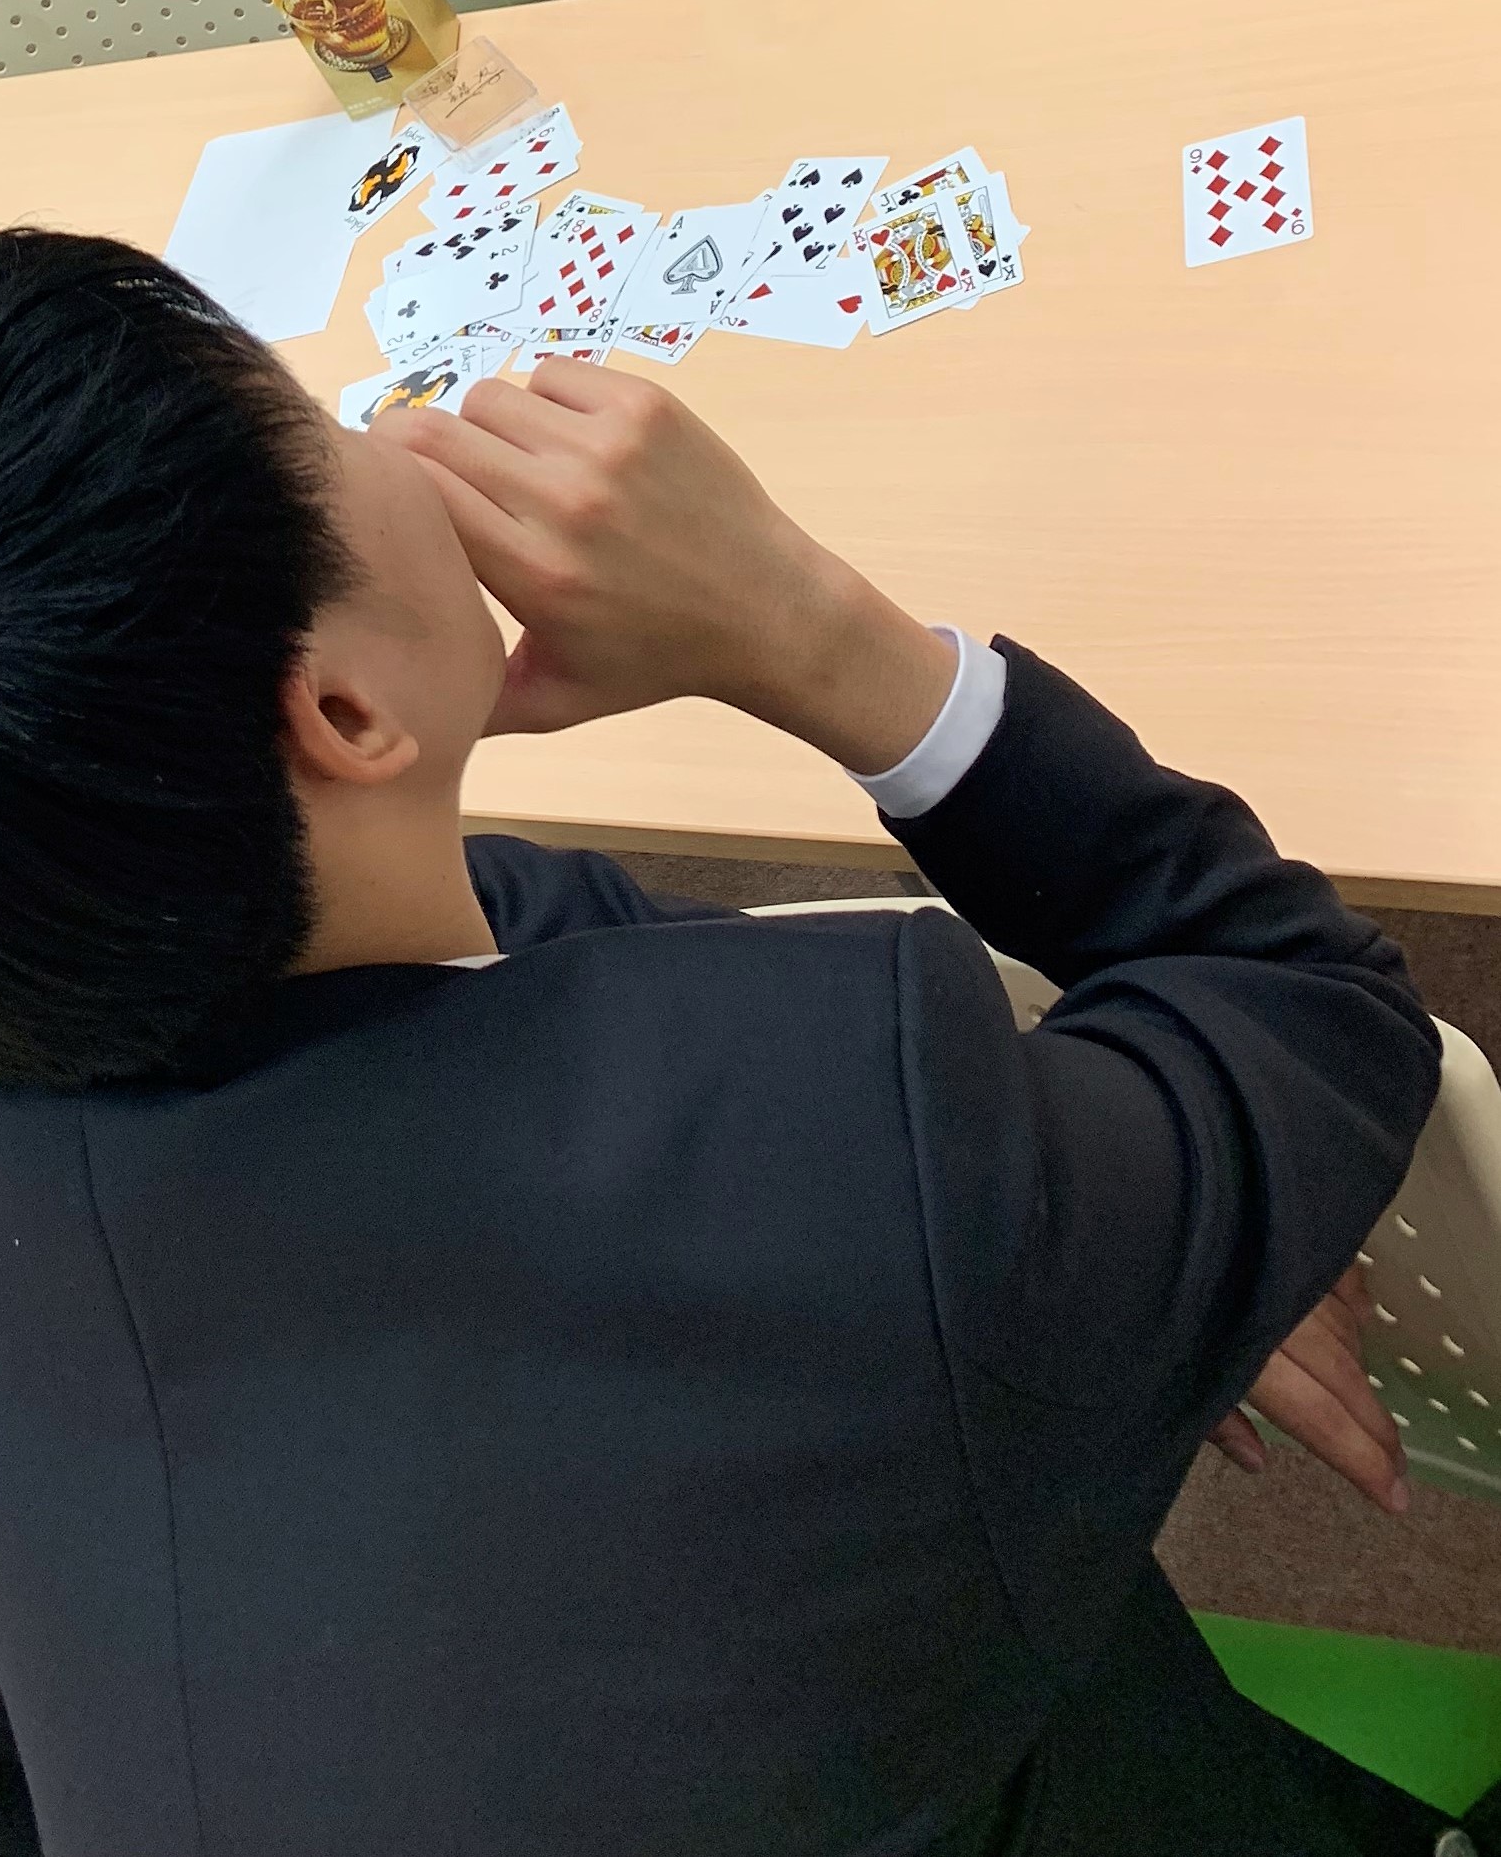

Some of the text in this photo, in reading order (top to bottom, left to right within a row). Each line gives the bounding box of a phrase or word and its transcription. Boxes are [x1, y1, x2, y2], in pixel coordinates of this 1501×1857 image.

[1190, 149, 1203, 164] 9
[796, 163, 809, 177] 7
[564, 195, 581, 209] K
[880, 192, 891, 208] J
[559, 218, 574, 231] A
[572, 219, 586, 233] 8
[672, 215, 684, 231] A
[854, 229, 866, 244] K
[1002, 263, 1017, 281] K
[960, 276, 976, 292] K
[710, 299, 722, 316] A
[588, 308, 603, 323] 8
